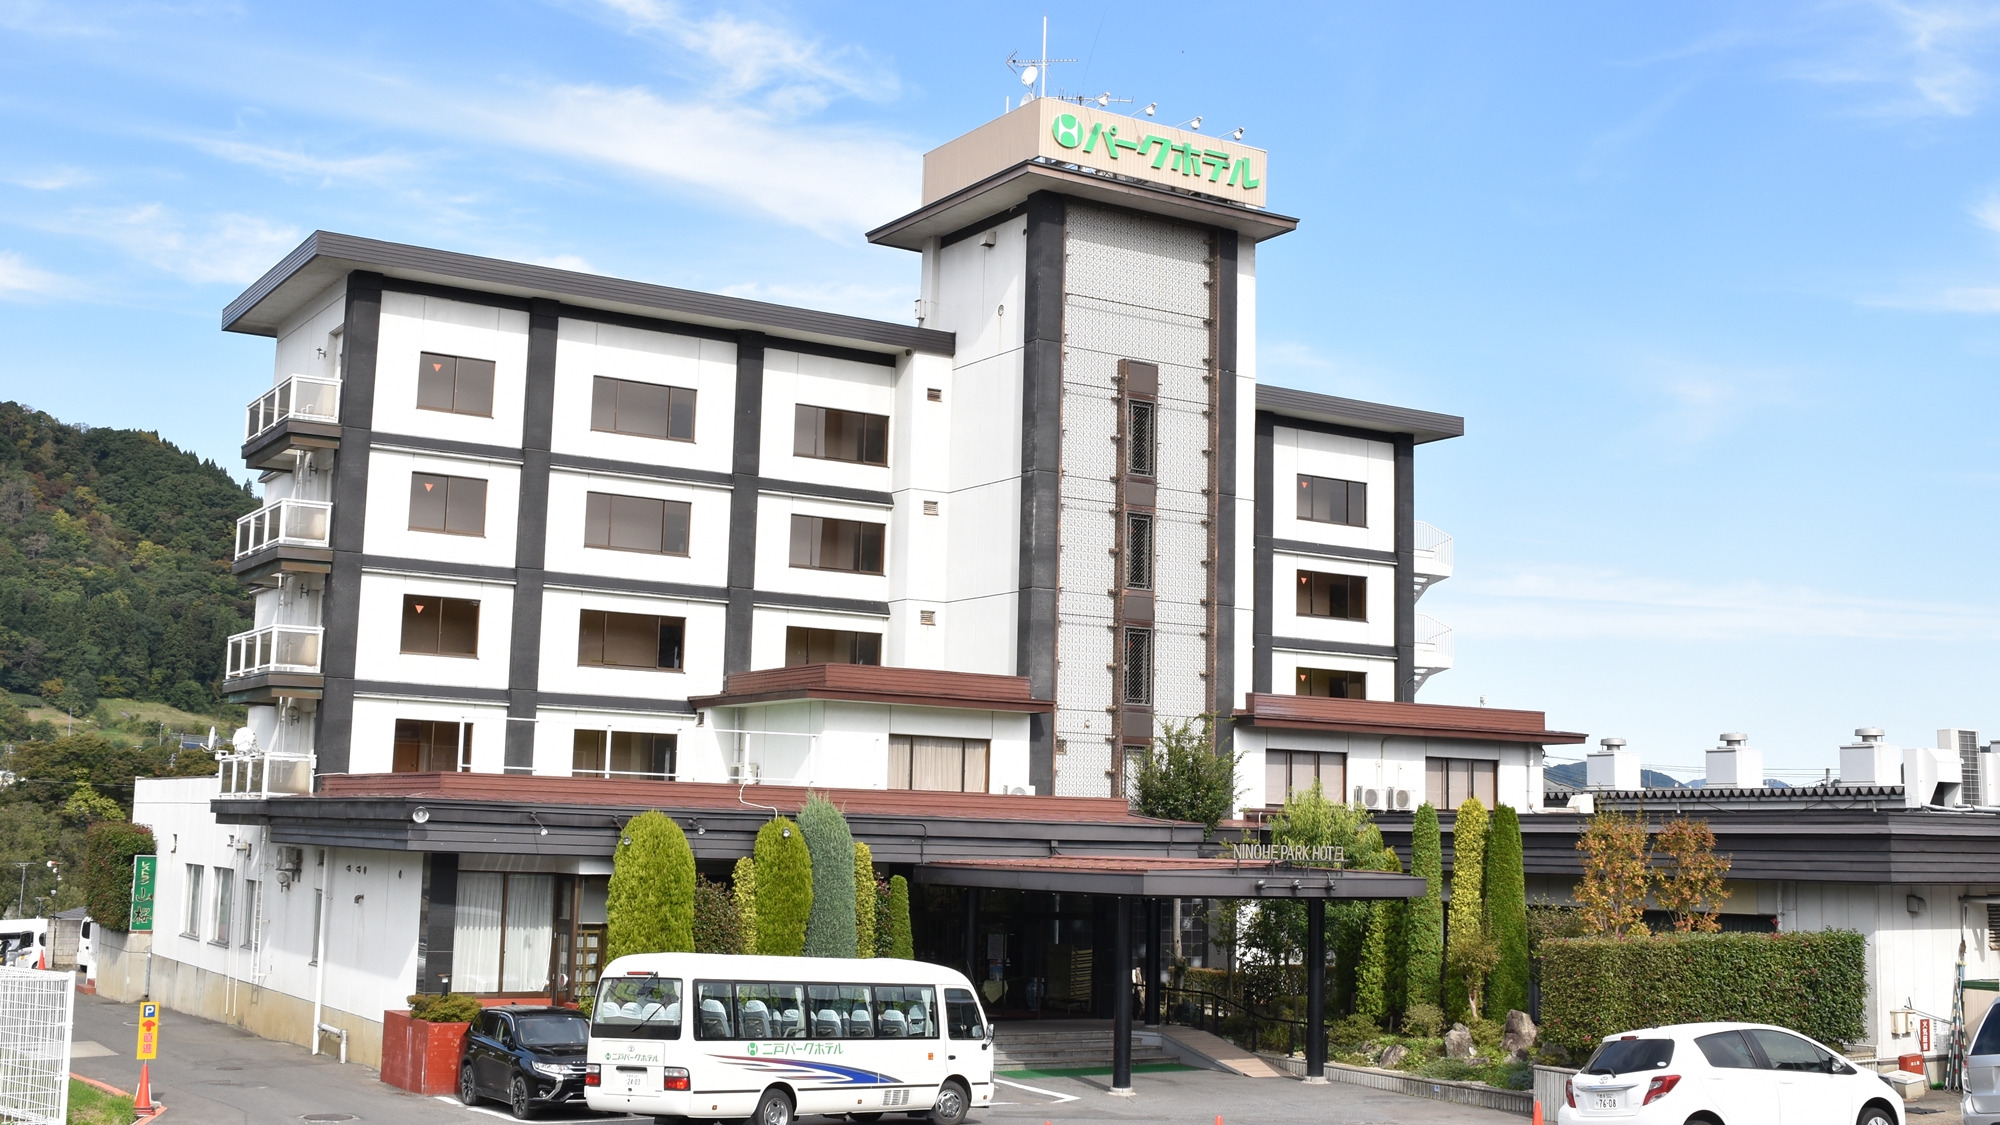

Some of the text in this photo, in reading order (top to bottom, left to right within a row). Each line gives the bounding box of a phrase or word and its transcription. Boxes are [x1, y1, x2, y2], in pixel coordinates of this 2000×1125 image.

[1083, 122, 1260, 189] パークホテル
[1233, 843, 1279, 860] NINOHE
[1280, 844, 1310, 861] PARK
[145, 1005, 154, 1017] P
[763, 1042, 844, 1056] 二戸パークホテル
[612, 1053, 659, 1062] 二戸パークホテル
[1599, 1098, 1617, 1109] 76-08
